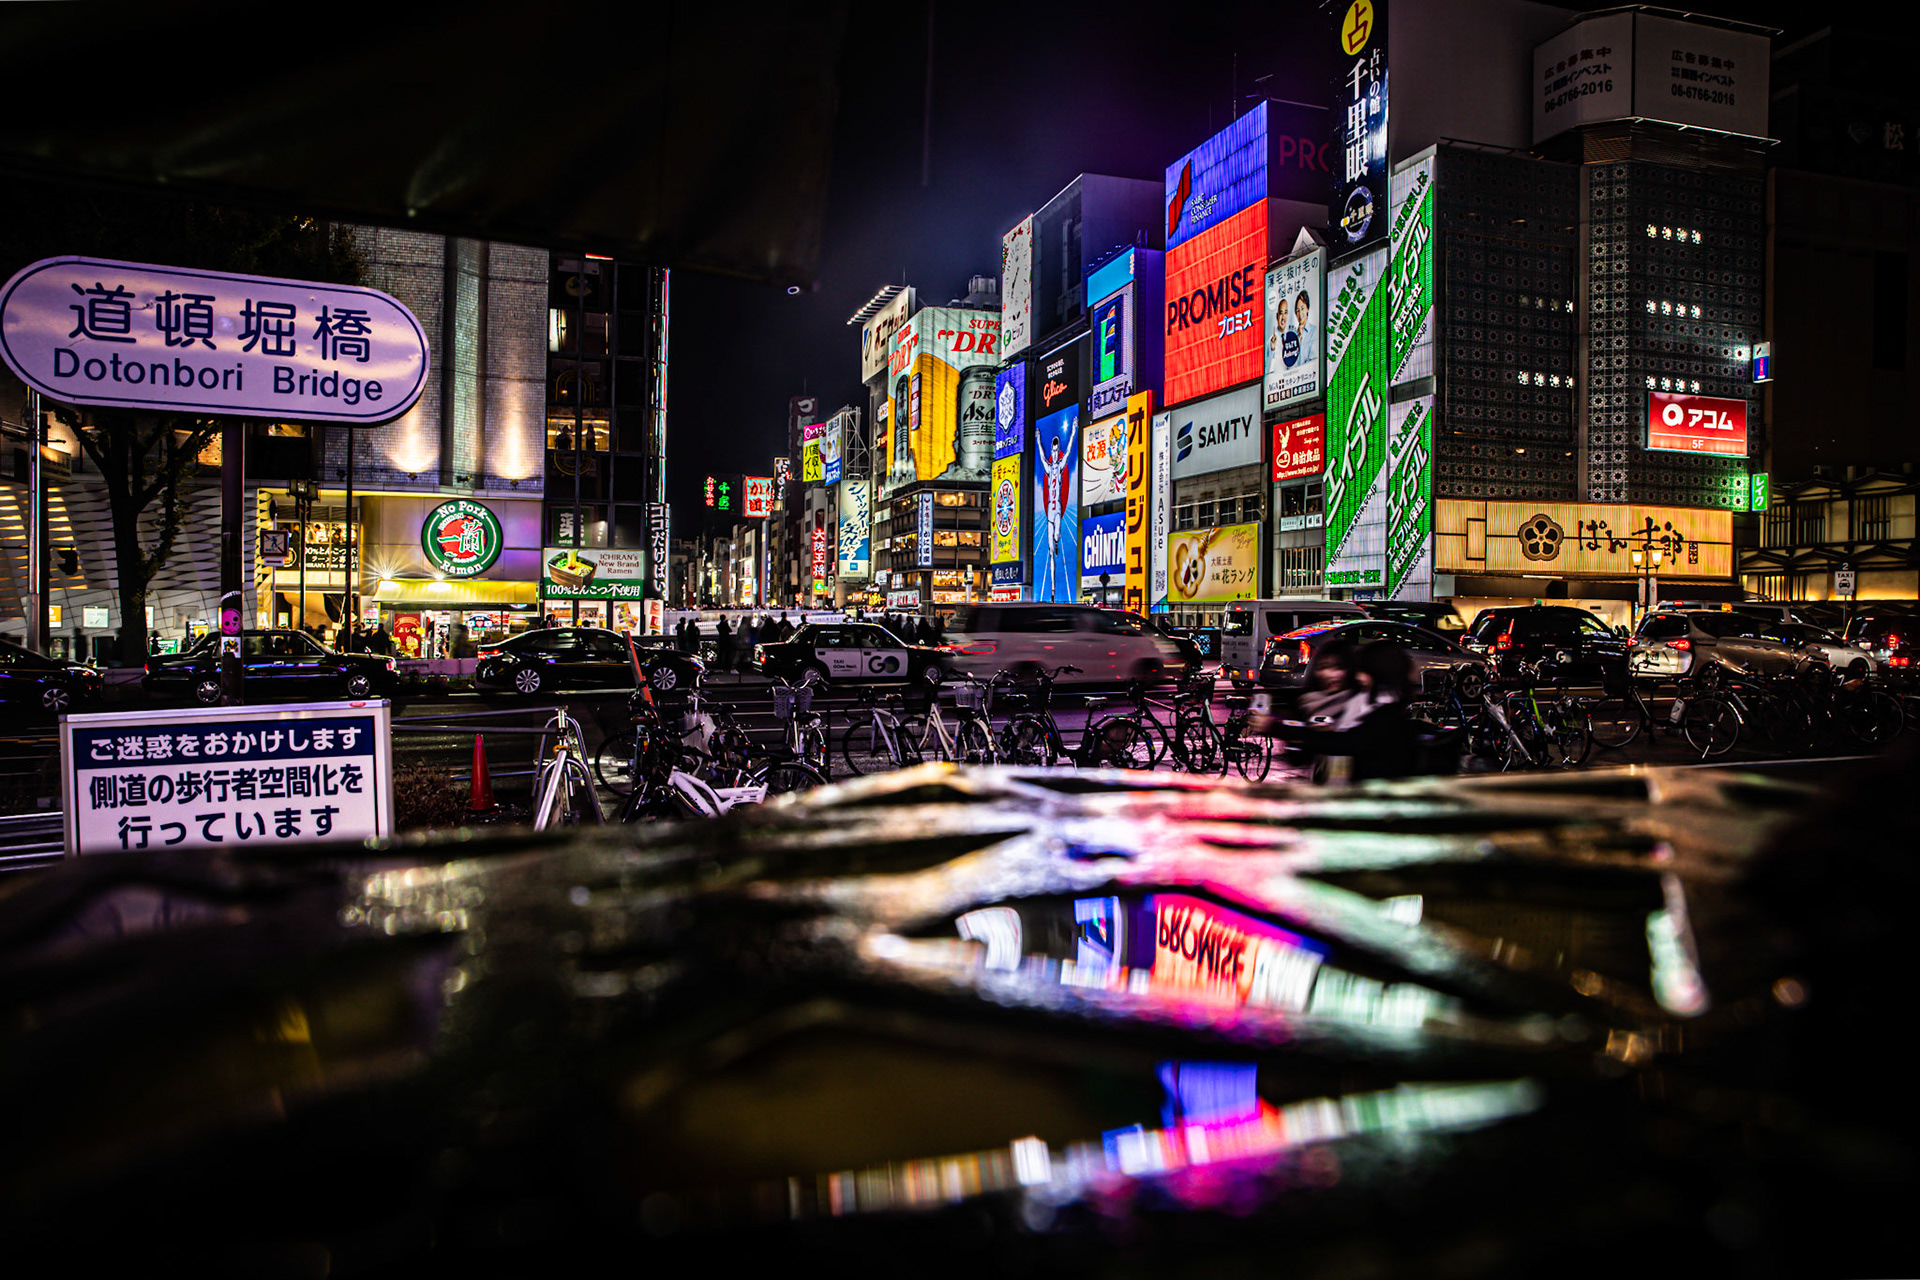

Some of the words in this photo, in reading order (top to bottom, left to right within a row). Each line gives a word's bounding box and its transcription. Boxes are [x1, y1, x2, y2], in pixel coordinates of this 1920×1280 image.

[1347, 3, 1368, 52] 占
[1544, 46, 1611, 80] 広告募集中
[1672, 50, 1735, 71] 広告募集中
[1369, 48, 1380, 116] 占いの館
[1544, 79, 1613, 113] 06-6766-2016
[1671, 83, 1735, 106] 06-6766-2016
[1345, 58, 1369, 183] 千里眼
[1167, 264, 1255, 336] PROMISE
[69, 282, 371, 363] 道頓堀橋
[1218, 309, 1253, 340] プロミス
[54, 347, 243, 391] Dotonbori
[273, 366, 383, 405] Bridge
[1043, 380, 1068, 408] Glico
[1198, 414, 1253, 449] SAMTY
[1688, 408, 1734, 431] アコム
[1086, 439, 1106, 462] 改源
[1323, 386, 1381, 505] エイブル
[1692, 440, 1704, 449] 5F
[1387, 444, 1428, 524] エイブル
[1755, 477, 1765, 506] レイク
[437, 505, 455, 518] No
[459, 501, 487, 519] Pork
[437, 519, 484, 556] 一蘭
[811, 528, 826, 577] 大阪王将
[440, 560, 483, 575] Ramen
[600, 553, 637, 561] ICHIRAN's
[546, 583, 640, 597] 100%とんこつ不使用
[1222, 566, 1255, 584] 花ラング
[868, 656, 900, 674] GO
[90, 727, 362, 761] ご迷惑をおかけします
[89, 764, 363, 810] 側道の歩行者空間化を
[118, 805, 340, 850] 行っています
